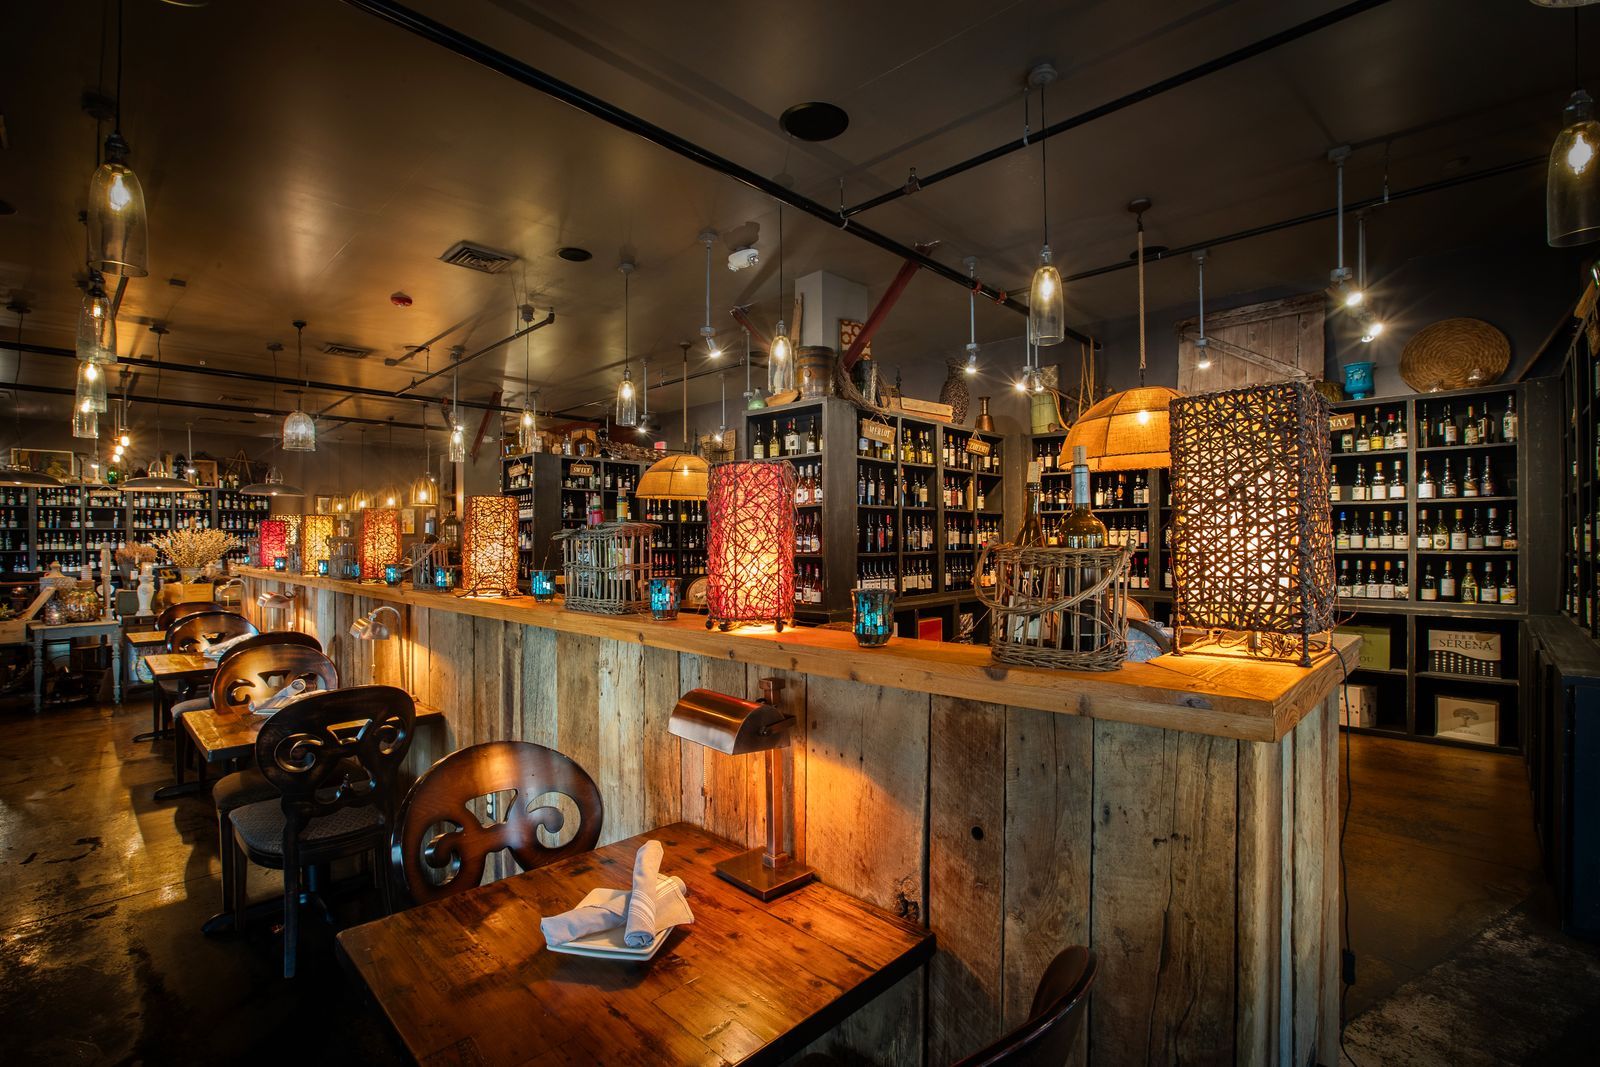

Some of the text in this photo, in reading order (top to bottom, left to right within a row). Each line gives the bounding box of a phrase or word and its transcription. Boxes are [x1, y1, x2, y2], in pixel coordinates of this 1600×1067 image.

[1330, 417, 1349, 427] NAY
[869, 425, 891, 438] MERLOT
[1439, 639, 1492, 650] SERENA
